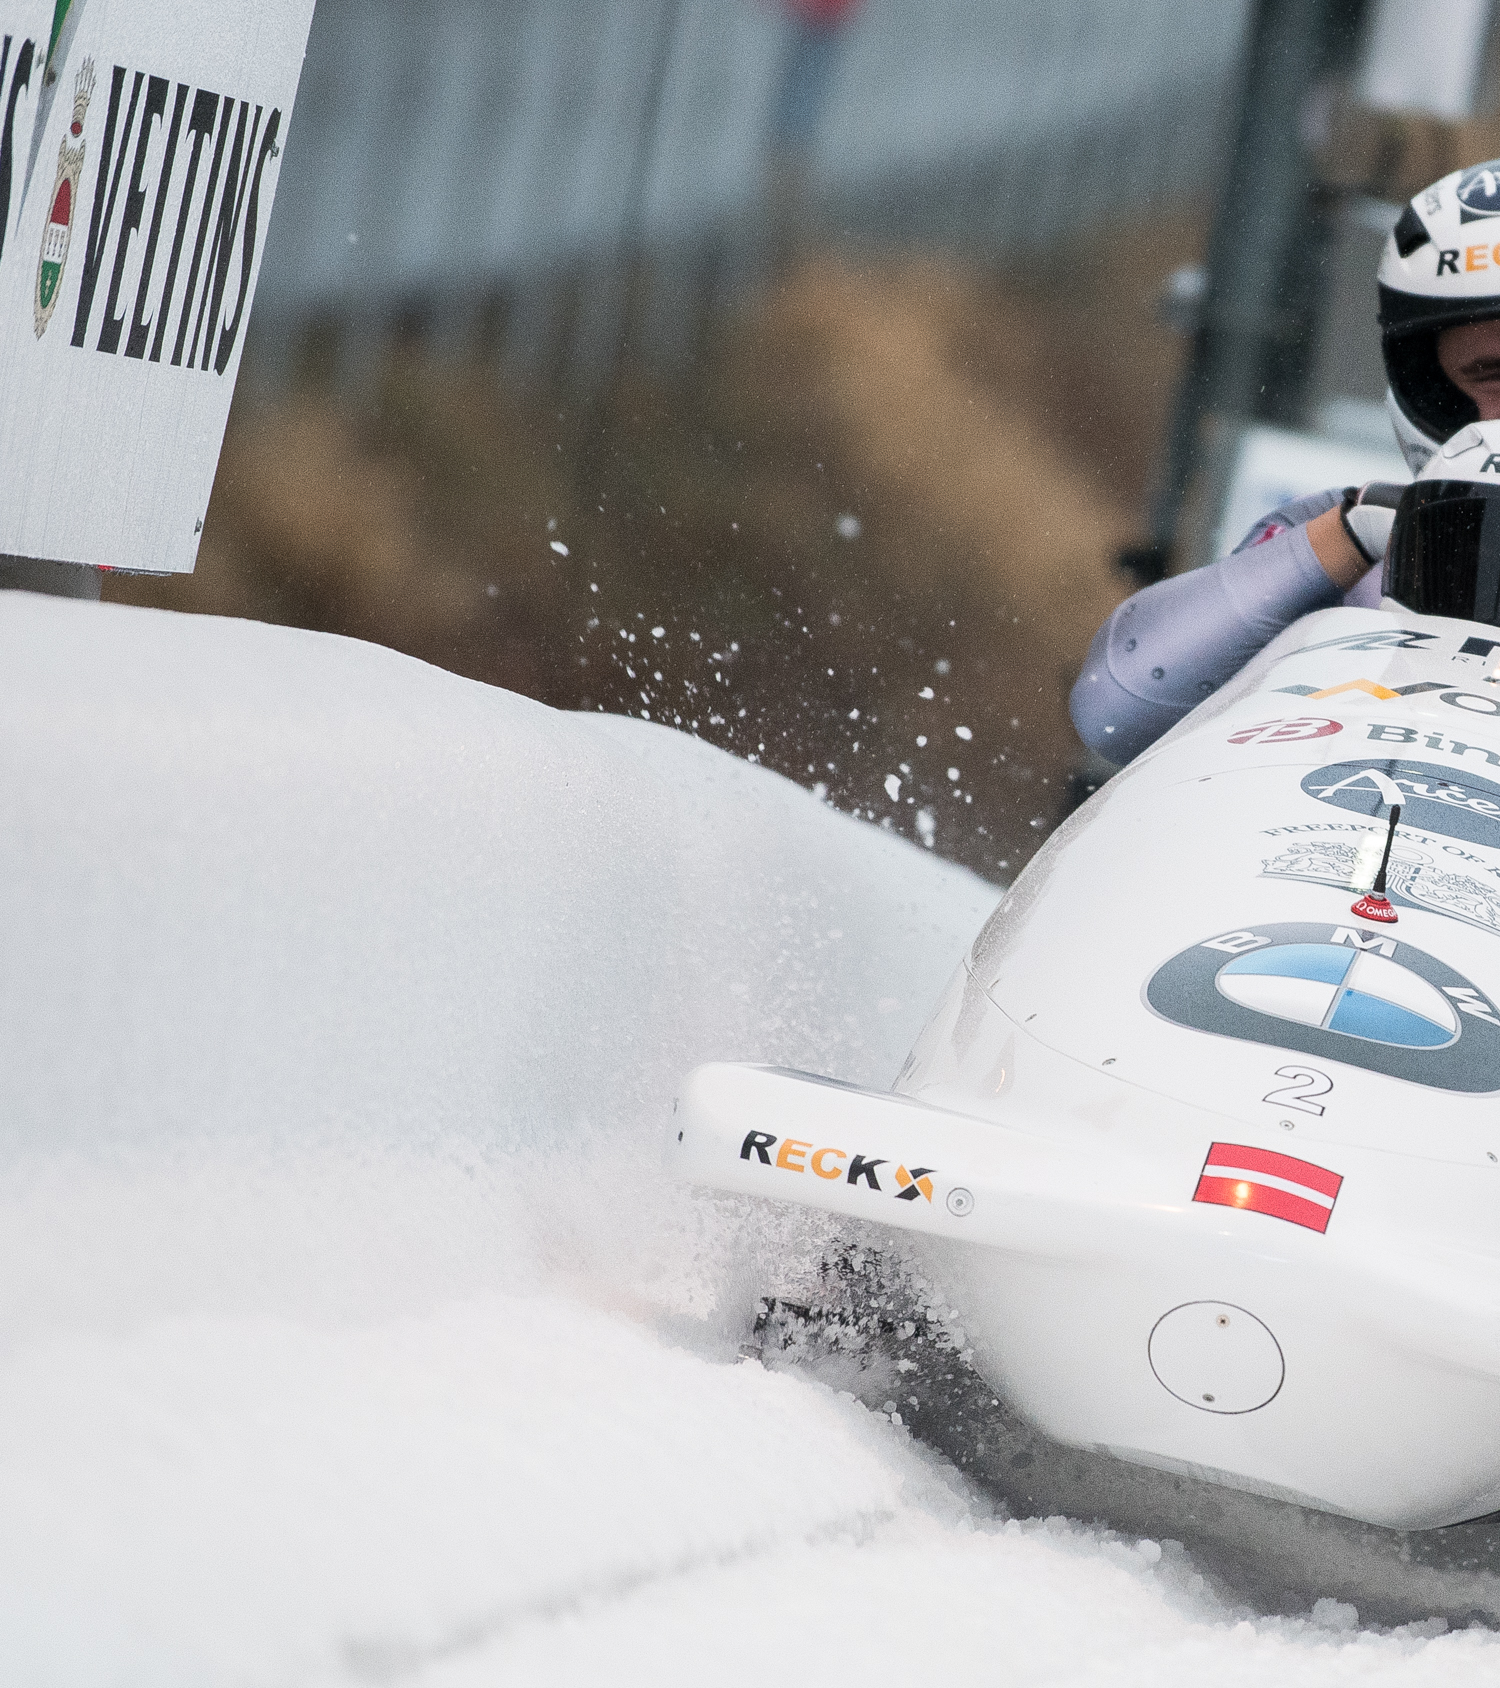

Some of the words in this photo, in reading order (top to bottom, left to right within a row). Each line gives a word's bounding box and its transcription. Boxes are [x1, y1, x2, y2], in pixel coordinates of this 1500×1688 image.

[70, 65, 282, 377] VELTINS
[1441, 845, 1486, 863] OF
[1261, 1064, 1335, 1117] 2
